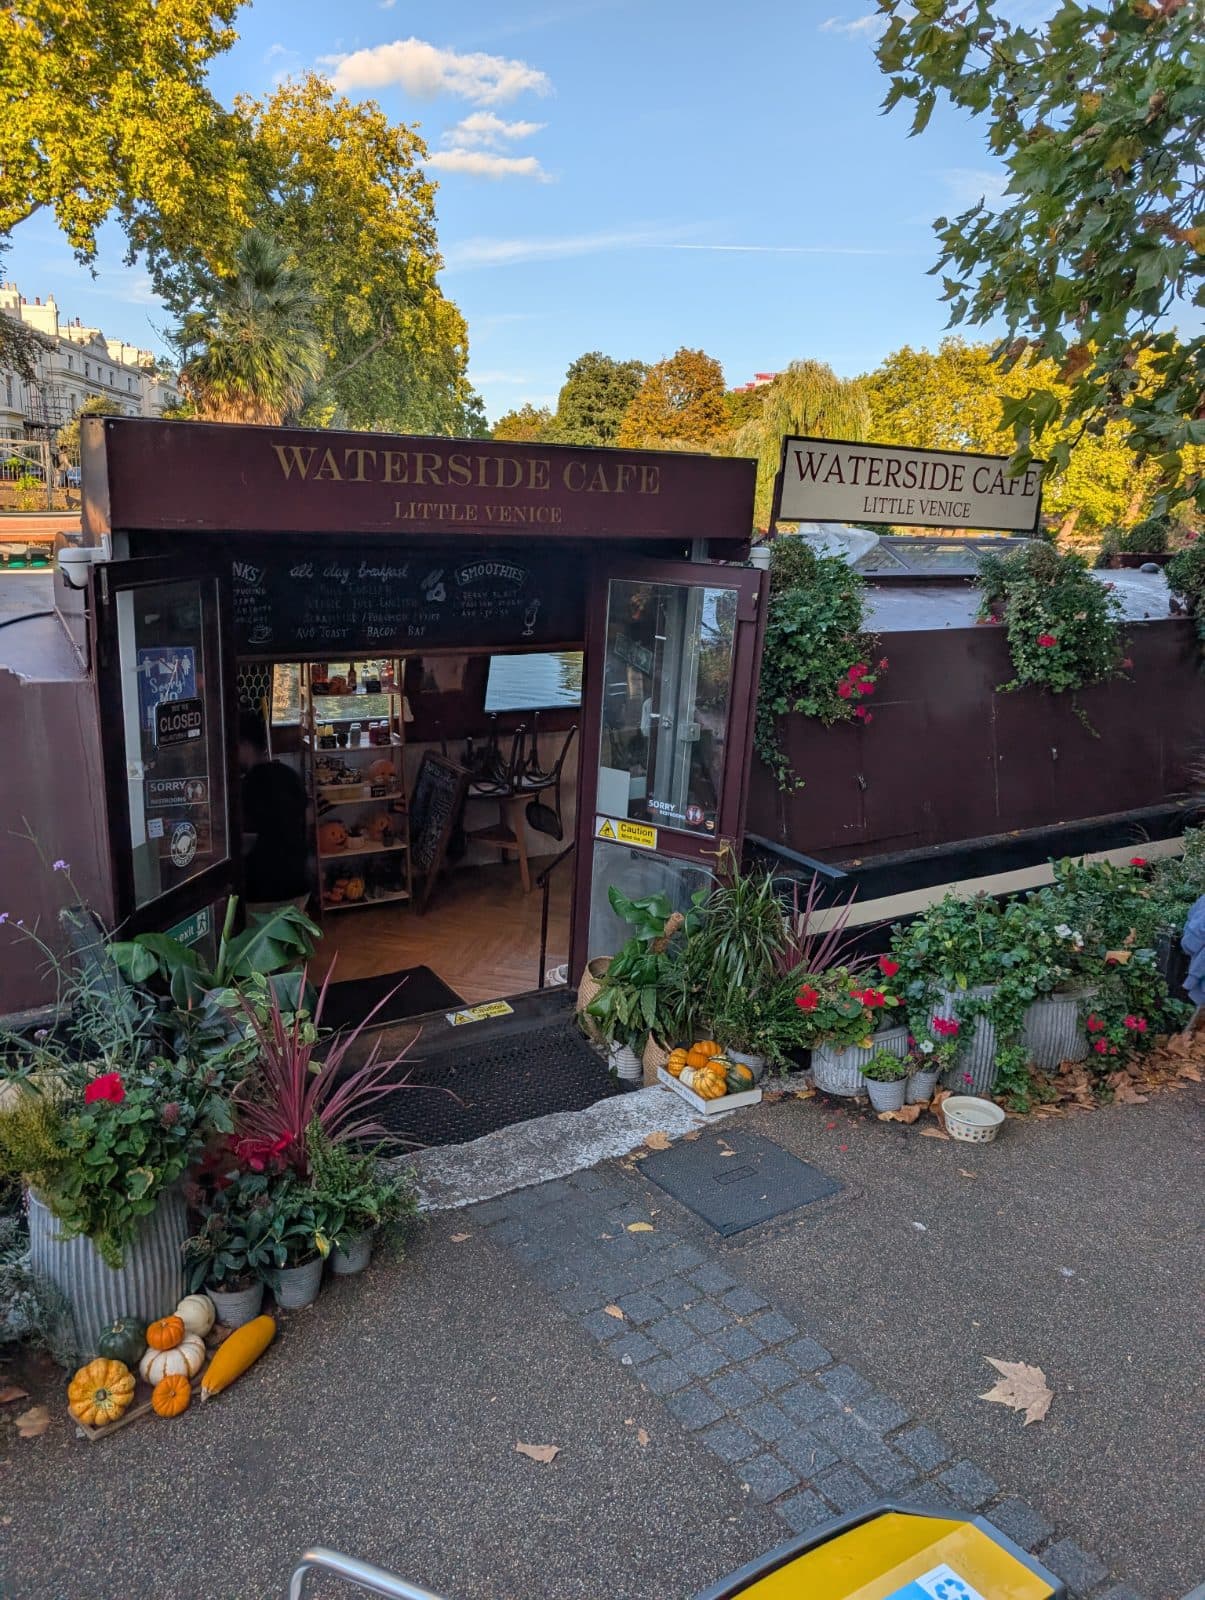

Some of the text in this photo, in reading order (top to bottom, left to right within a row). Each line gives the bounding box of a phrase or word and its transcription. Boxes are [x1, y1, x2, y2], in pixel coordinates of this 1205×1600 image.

[272, 445, 661, 494] WATERSIDE CAFE
[793, 450, 965, 492] WATERSIDE
[394, 501, 562, 523] LITTLE VENICE
[862, 496, 971, 518] LITTLE VENICE
[232, 560, 260, 582] NKS
[322, 561, 350, 584] day
[461, 563, 524, 582] SMOOTHIES
[160, 711, 202, 733] CLOSED
[150, 781, 187, 793] SORRY
[648, 800, 675, 811] SORRY
[621, 824, 652, 837] Caution
[179, 925, 195, 942] exit
